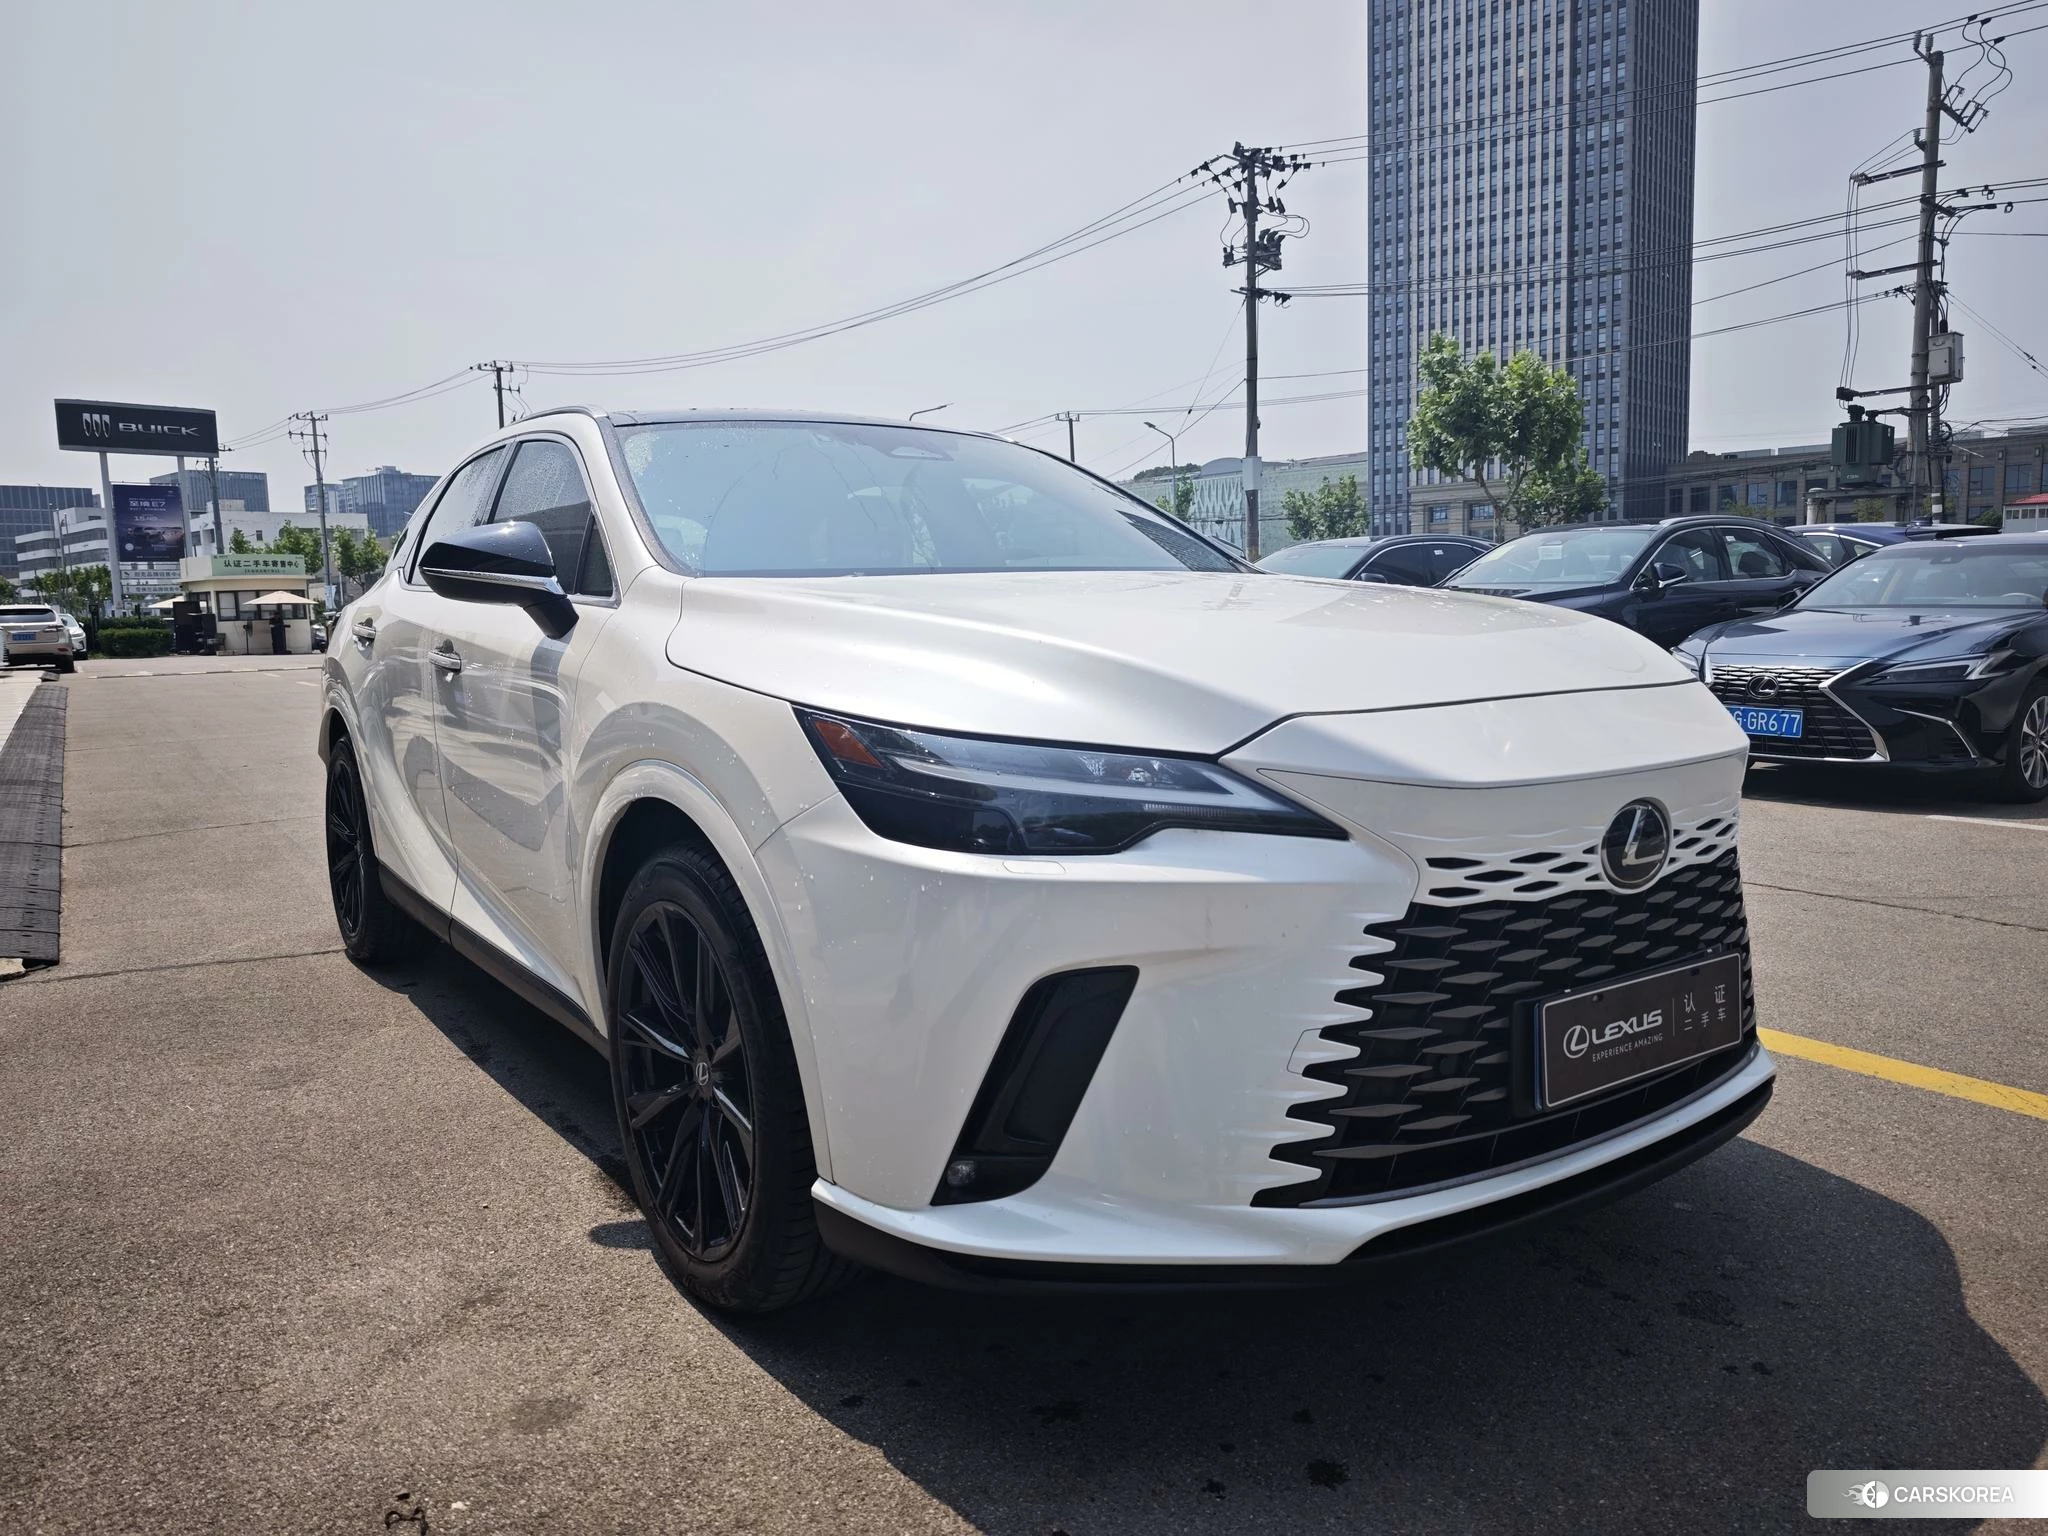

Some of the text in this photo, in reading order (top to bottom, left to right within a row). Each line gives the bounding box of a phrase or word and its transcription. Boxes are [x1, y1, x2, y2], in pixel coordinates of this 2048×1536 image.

[118, 422, 201, 437] BUICK
[1684, 984, 1726, 1013] 认证
[1591, 1009, 1663, 1044] LEXUS
[1684, 1007, 1727, 1031] 二手车
[1592, 1033, 1664, 1063] EXPERIENCE AMAZING
